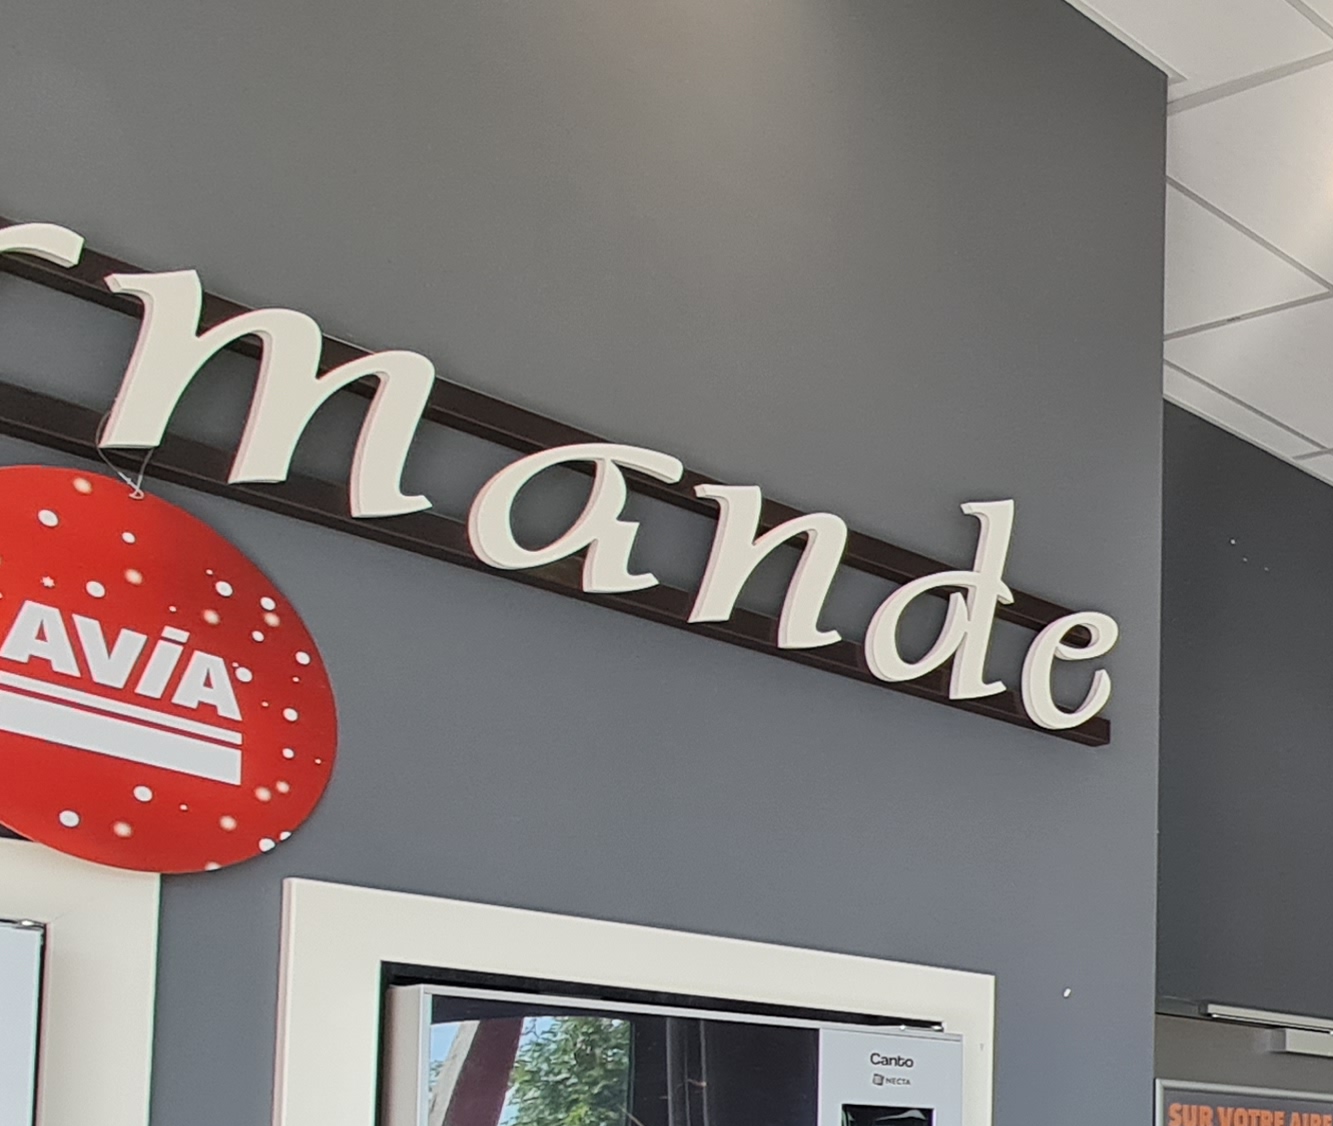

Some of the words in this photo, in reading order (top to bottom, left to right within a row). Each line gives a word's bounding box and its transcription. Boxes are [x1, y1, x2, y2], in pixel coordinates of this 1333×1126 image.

[0, 598, 243, 721] AVIA
[869, 1052, 914, 1069] Canto
[885, 1077, 911, 1086] NECTA
